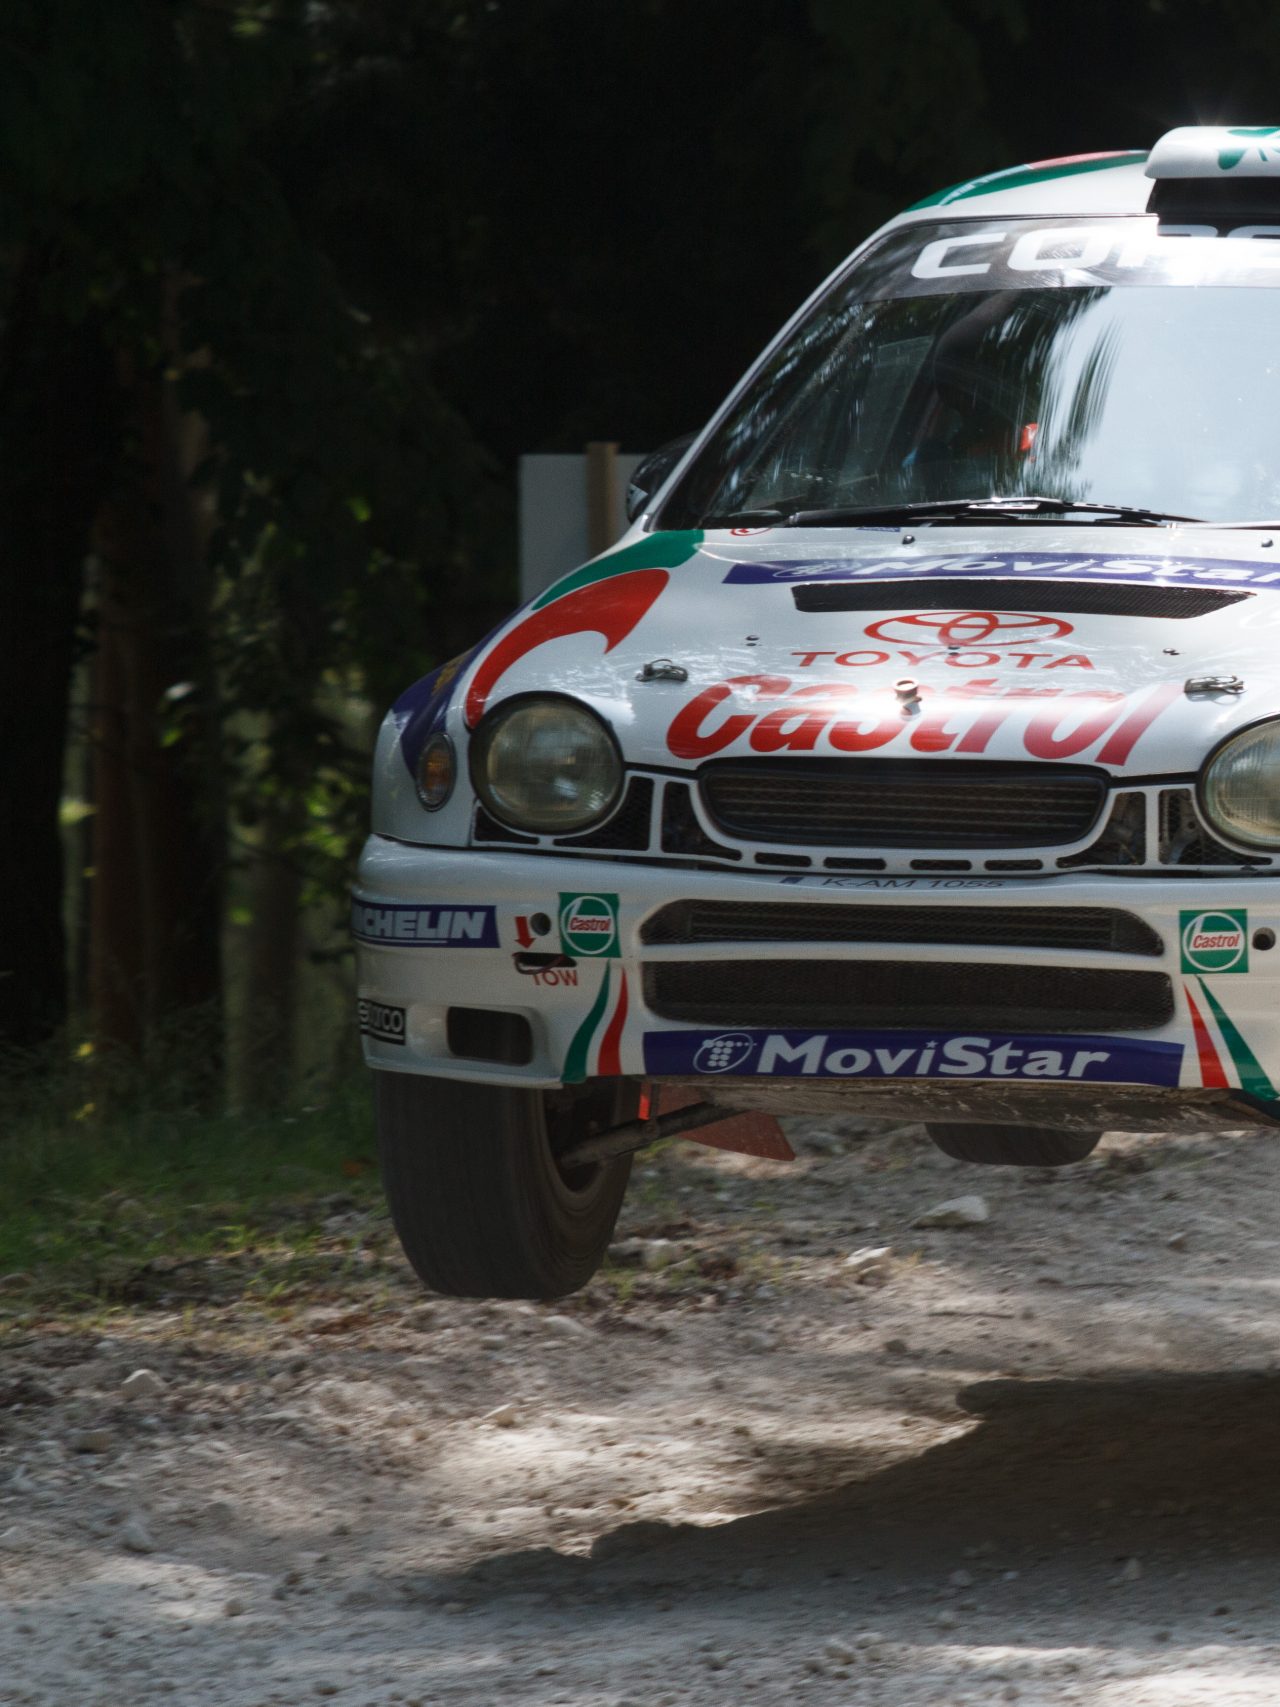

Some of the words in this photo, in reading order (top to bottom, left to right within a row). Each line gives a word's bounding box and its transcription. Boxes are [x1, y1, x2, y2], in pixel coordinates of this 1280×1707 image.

[790, 650, 1096, 670] TOYOTA
[665, 675, 1185, 766] Castrol
[822, 877, 917, 888] K-AM
[570, 917, 612, 933] Castrol
[1192, 933, 1240, 949] Castrol
[757, 1035, 1111, 1078] MoviStar
